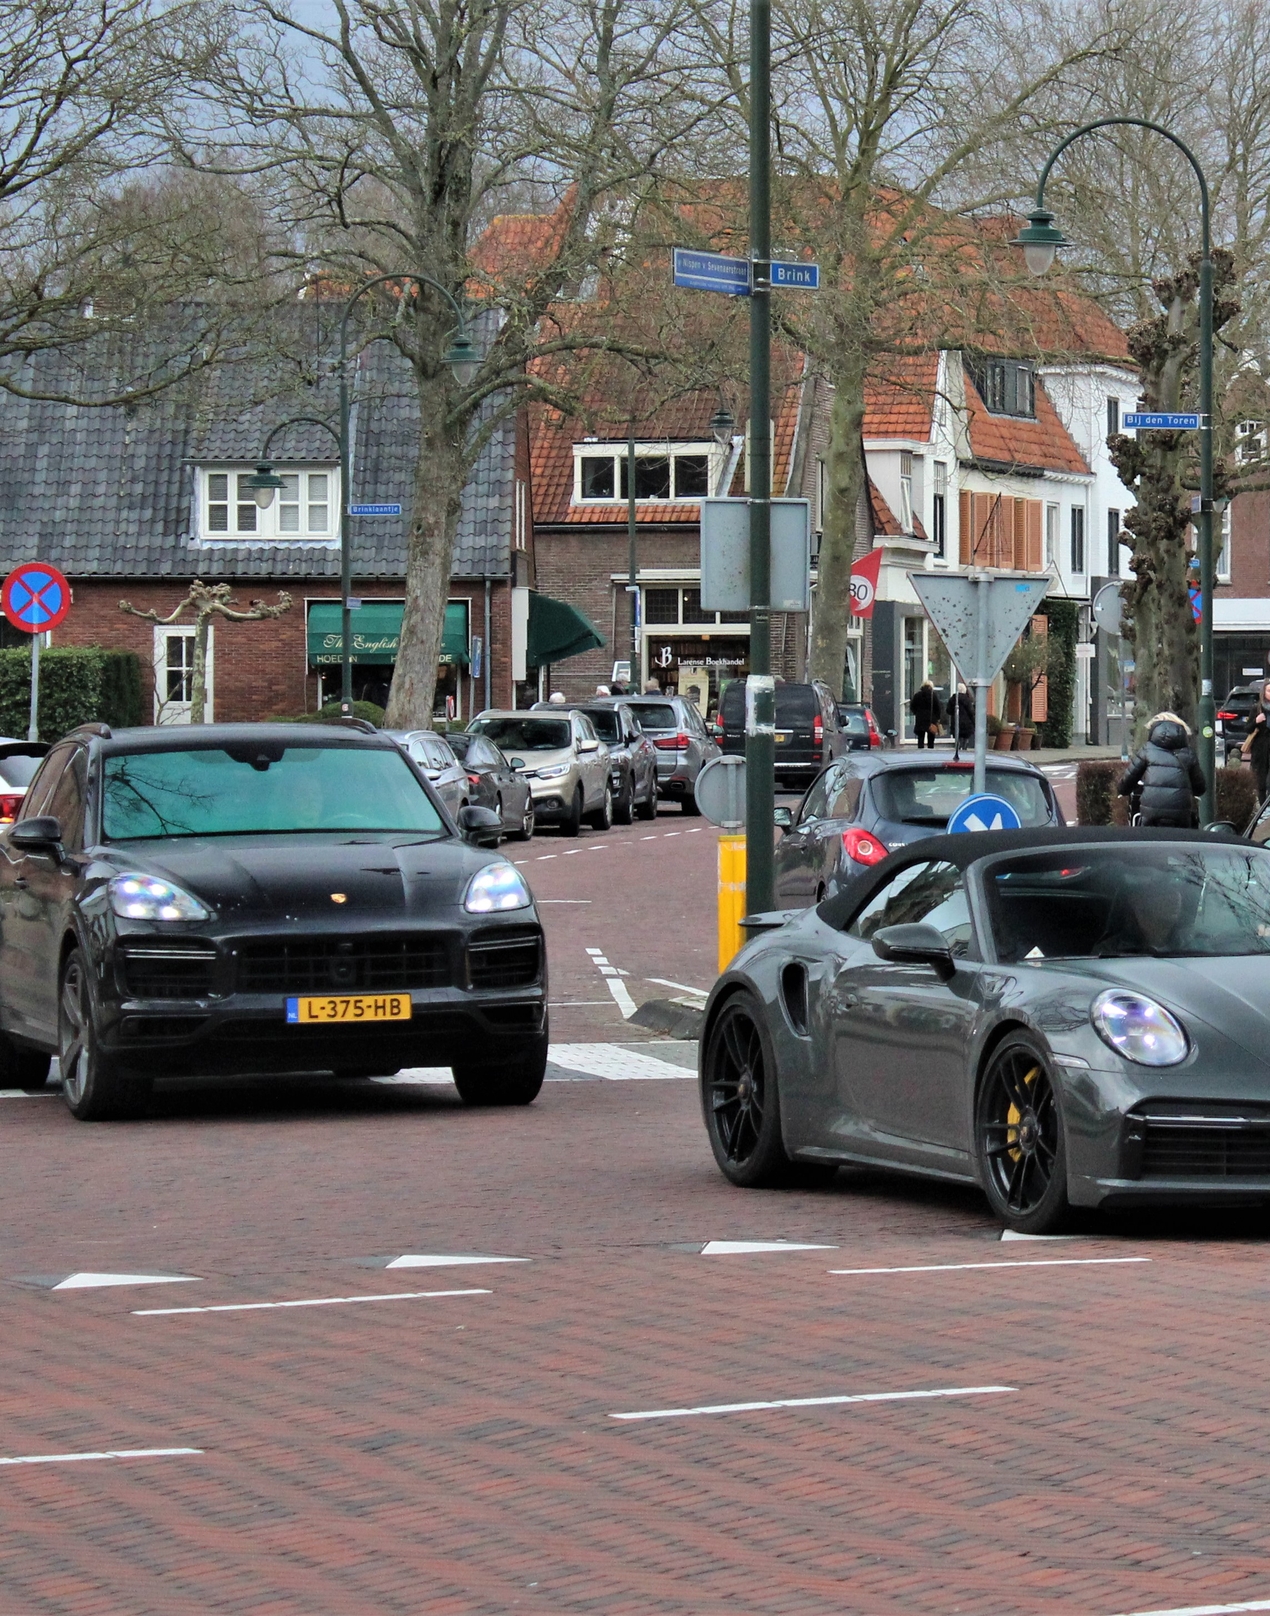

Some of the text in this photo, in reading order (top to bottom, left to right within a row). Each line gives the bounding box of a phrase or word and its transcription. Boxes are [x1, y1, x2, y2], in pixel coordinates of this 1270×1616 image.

[778, 267, 811, 282] Brink
[1127, 416, 1195, 425] Bij den Toren
[352, 506, 399, 514] Brinklaantje
[323, 634, 399, 653] Th English
[316, 654, 358, 663] HOEDN
[677, 657, 745, 666] Larense Boekhandel
[307, 998, 402, 1019] L-375-HB
